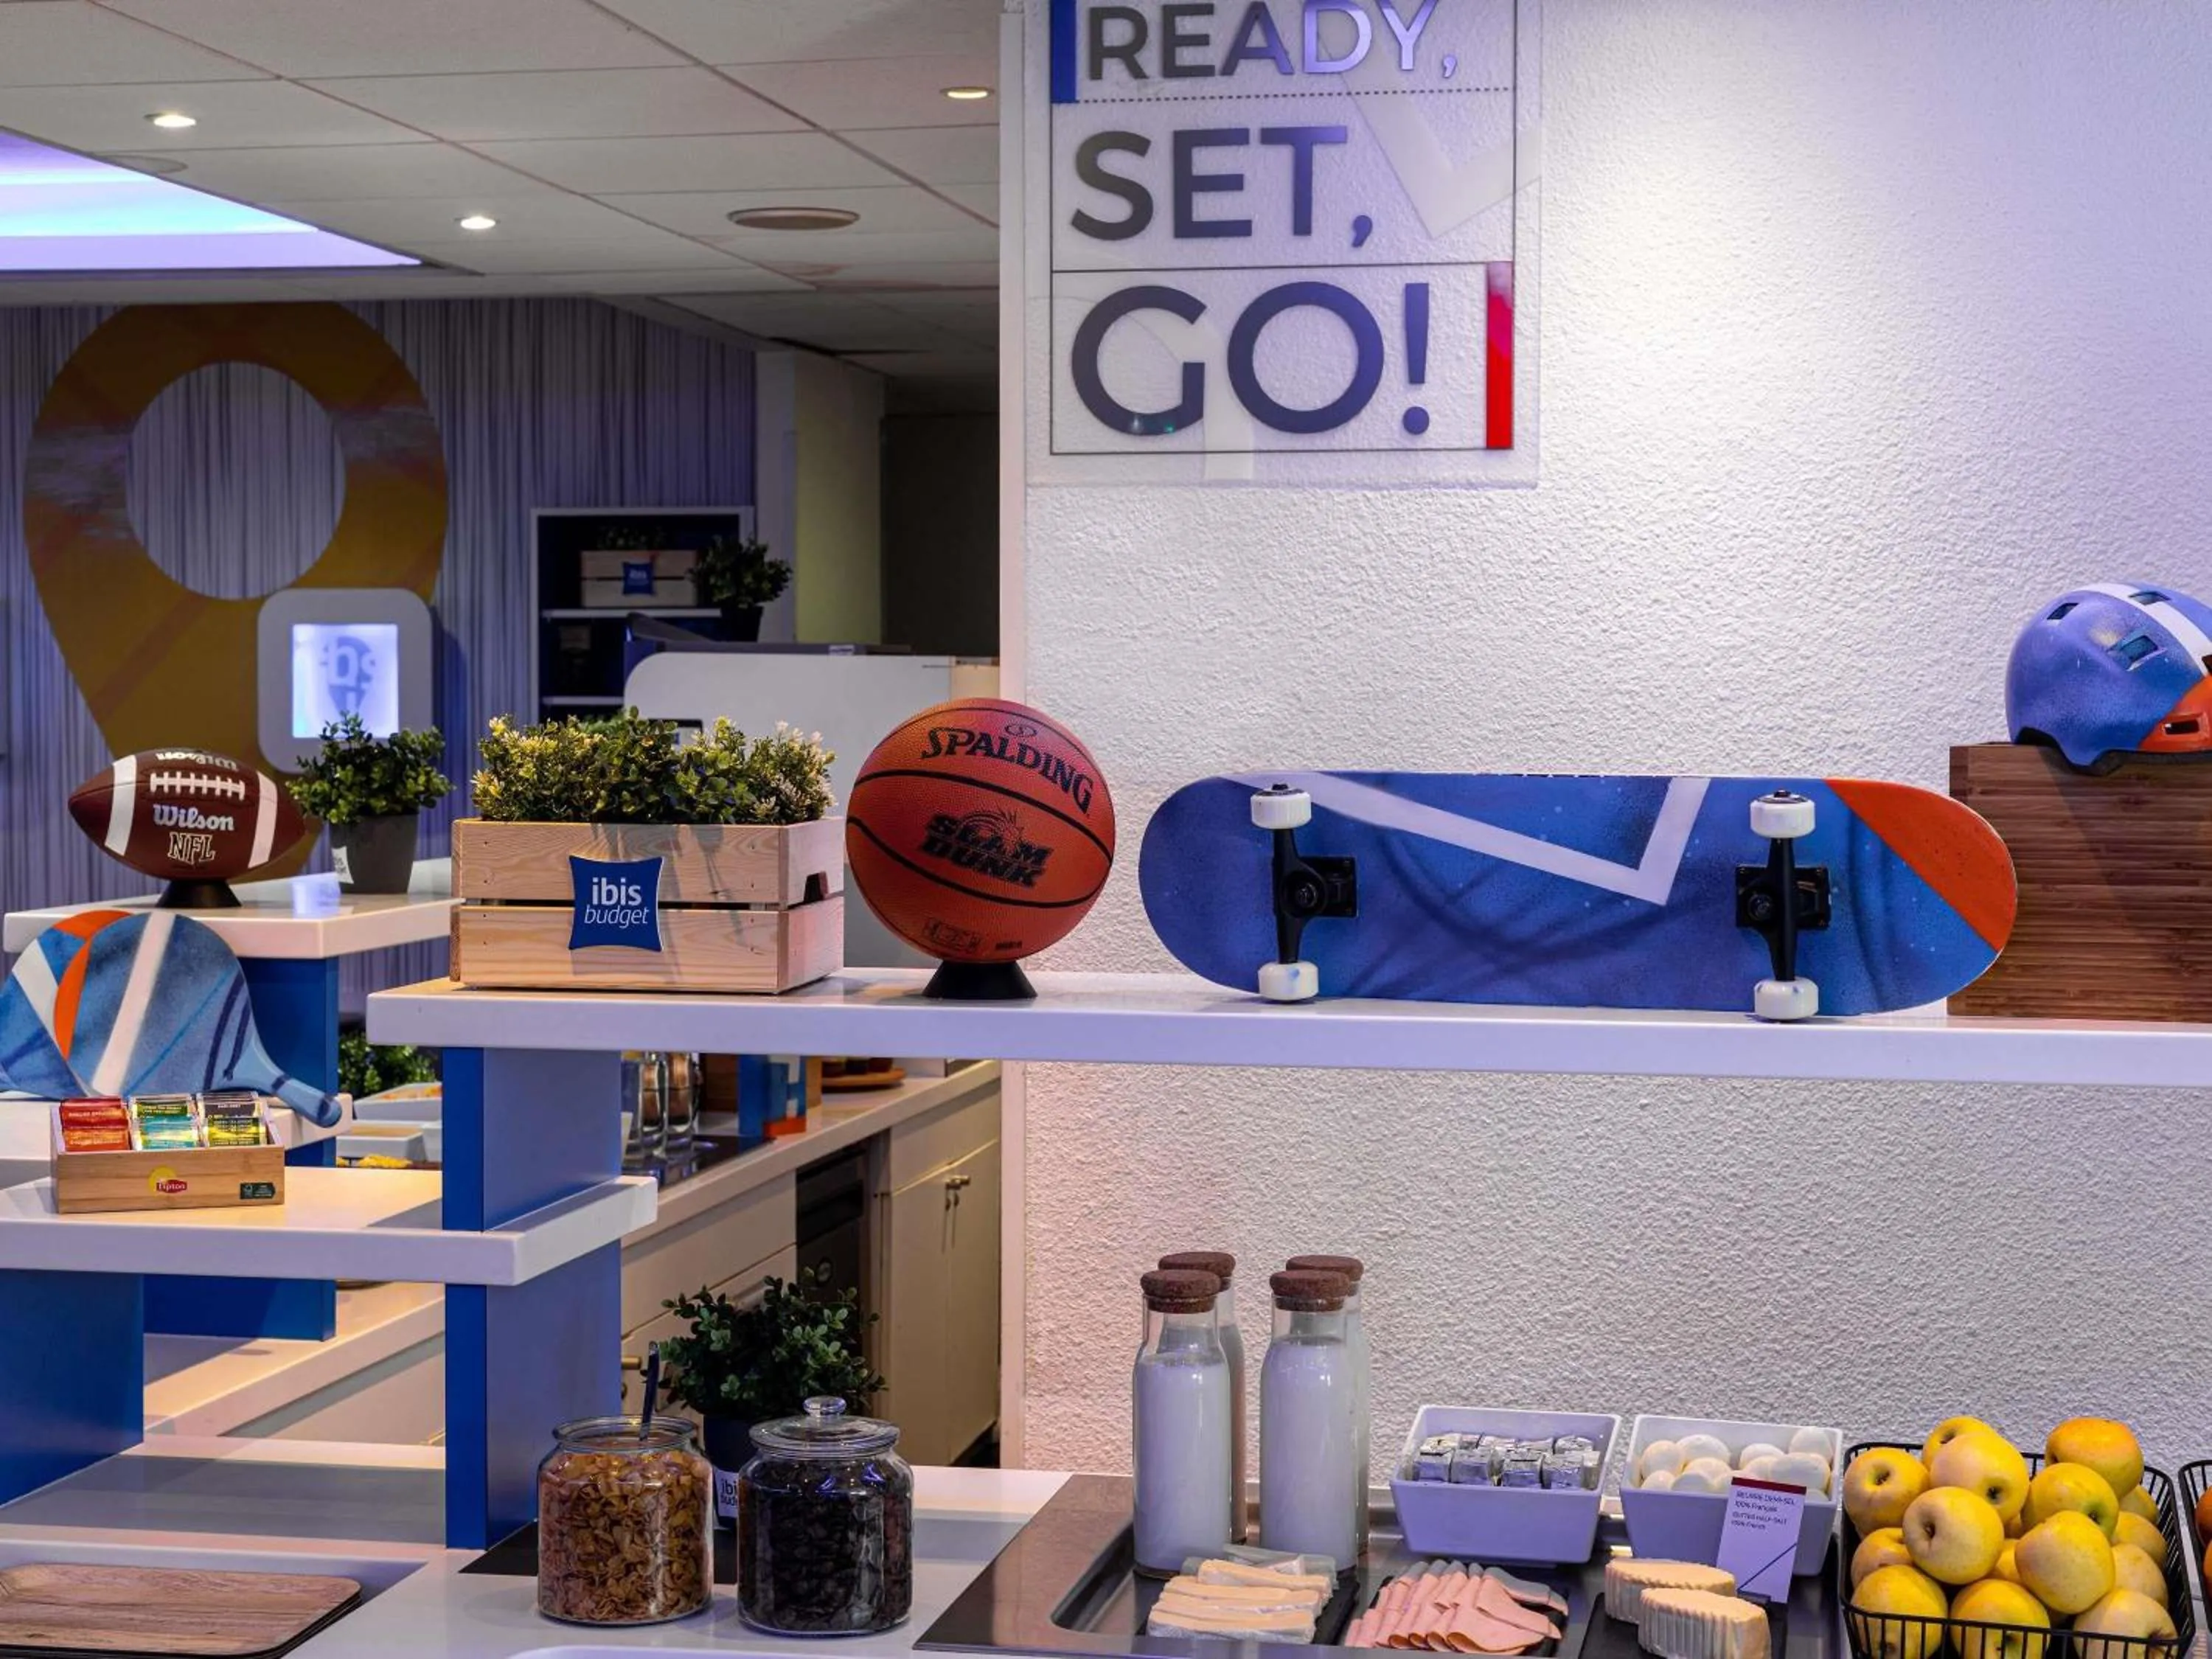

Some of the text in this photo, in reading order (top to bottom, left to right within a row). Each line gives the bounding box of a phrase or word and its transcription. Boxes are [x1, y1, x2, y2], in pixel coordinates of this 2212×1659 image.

[1088, 0, 1458, 80] READY,
[1069, 125, 1373, 247] SET,
[1071, 281, 1430, 436] GO!
[920, 726, 1095, 815] SPALDING
[153, 803, 234, 831] Wilson
[167, 832, 215, 865] NFL
[583, 904, 650, 929] budget
[592, 877, 642, 906] ibis
